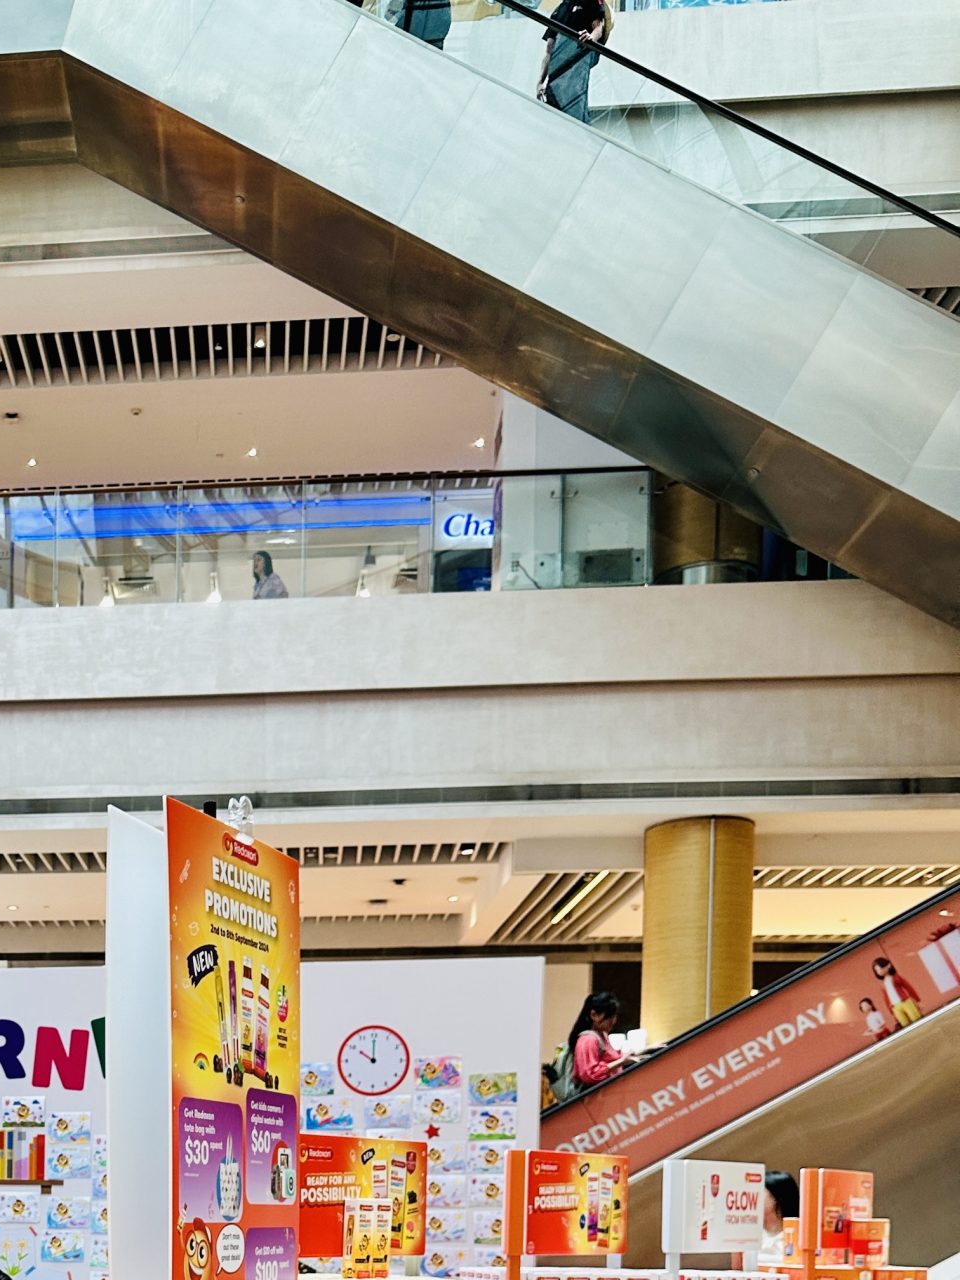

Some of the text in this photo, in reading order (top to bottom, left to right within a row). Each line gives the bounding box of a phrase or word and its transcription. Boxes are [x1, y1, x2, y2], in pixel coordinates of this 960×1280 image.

[444, 513, 494, 538] Cha
[212, 856, 271, 903] EXCLUSIVE
[204, 888, 278, 938] PROMOTIONS
[210, 924, 219, 935] 2nd
[220, 928, 226, 937] to
[226, 929, 234, 940] 8th
[235, 932, 258, 949] September
[192, 950, 214, 976] NEW
[691, 1002, 827, 1090] EVERYDAY
[184, 1108, 195, 1118] Get
[655, 1116, 674, 1132] WITH
[675, 1106, 689, 1118] THE
[715, 1083, 733, 1096] NEW
[195, 1124, 205, 1136] bag
[205, 1126, 215, 1135] with
[251, 1126, 271, 1156] $60
[185, 1136, 209, 1168] $30
[306, 1175, 355, 1186] READY FOR ANY
[300, 1186, 361, 1203] POSSIBILITY
[725, 1190, 758, 1210] GLOW
